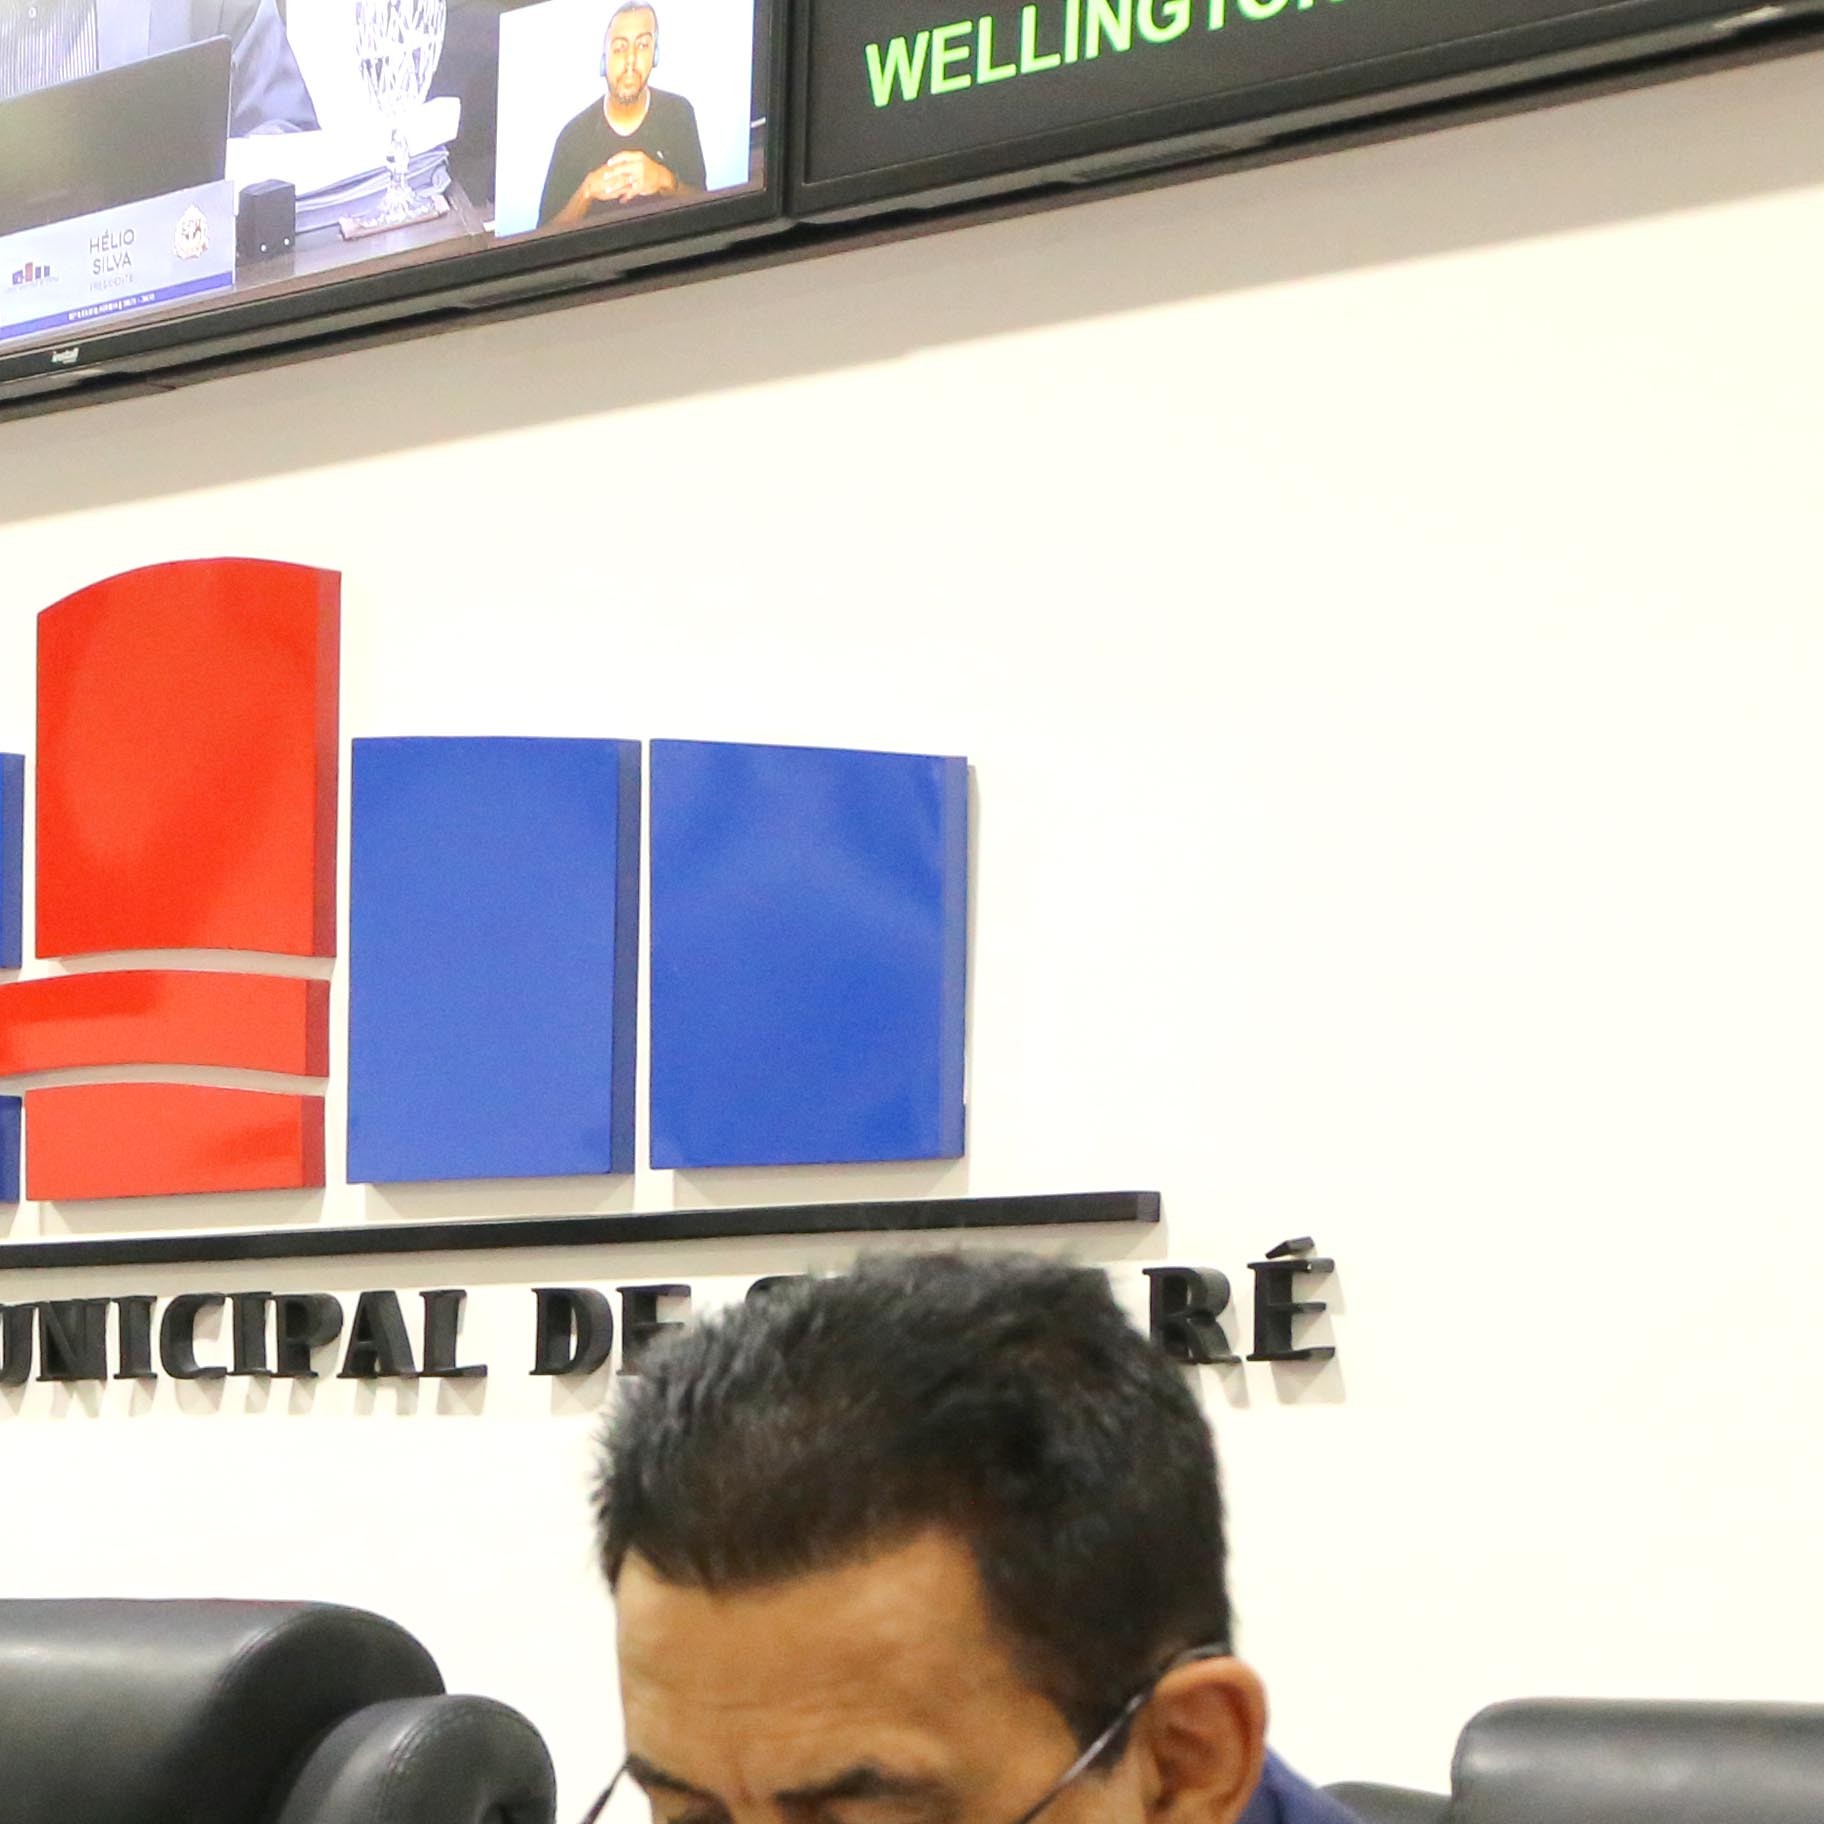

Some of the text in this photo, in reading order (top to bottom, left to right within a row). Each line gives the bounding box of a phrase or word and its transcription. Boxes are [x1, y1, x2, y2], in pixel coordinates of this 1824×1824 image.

[864, 0, 1356, 108] WELLING
[89, 228, 135, 255] HÉLIO
[93, 251, 132, 275] SILVA
